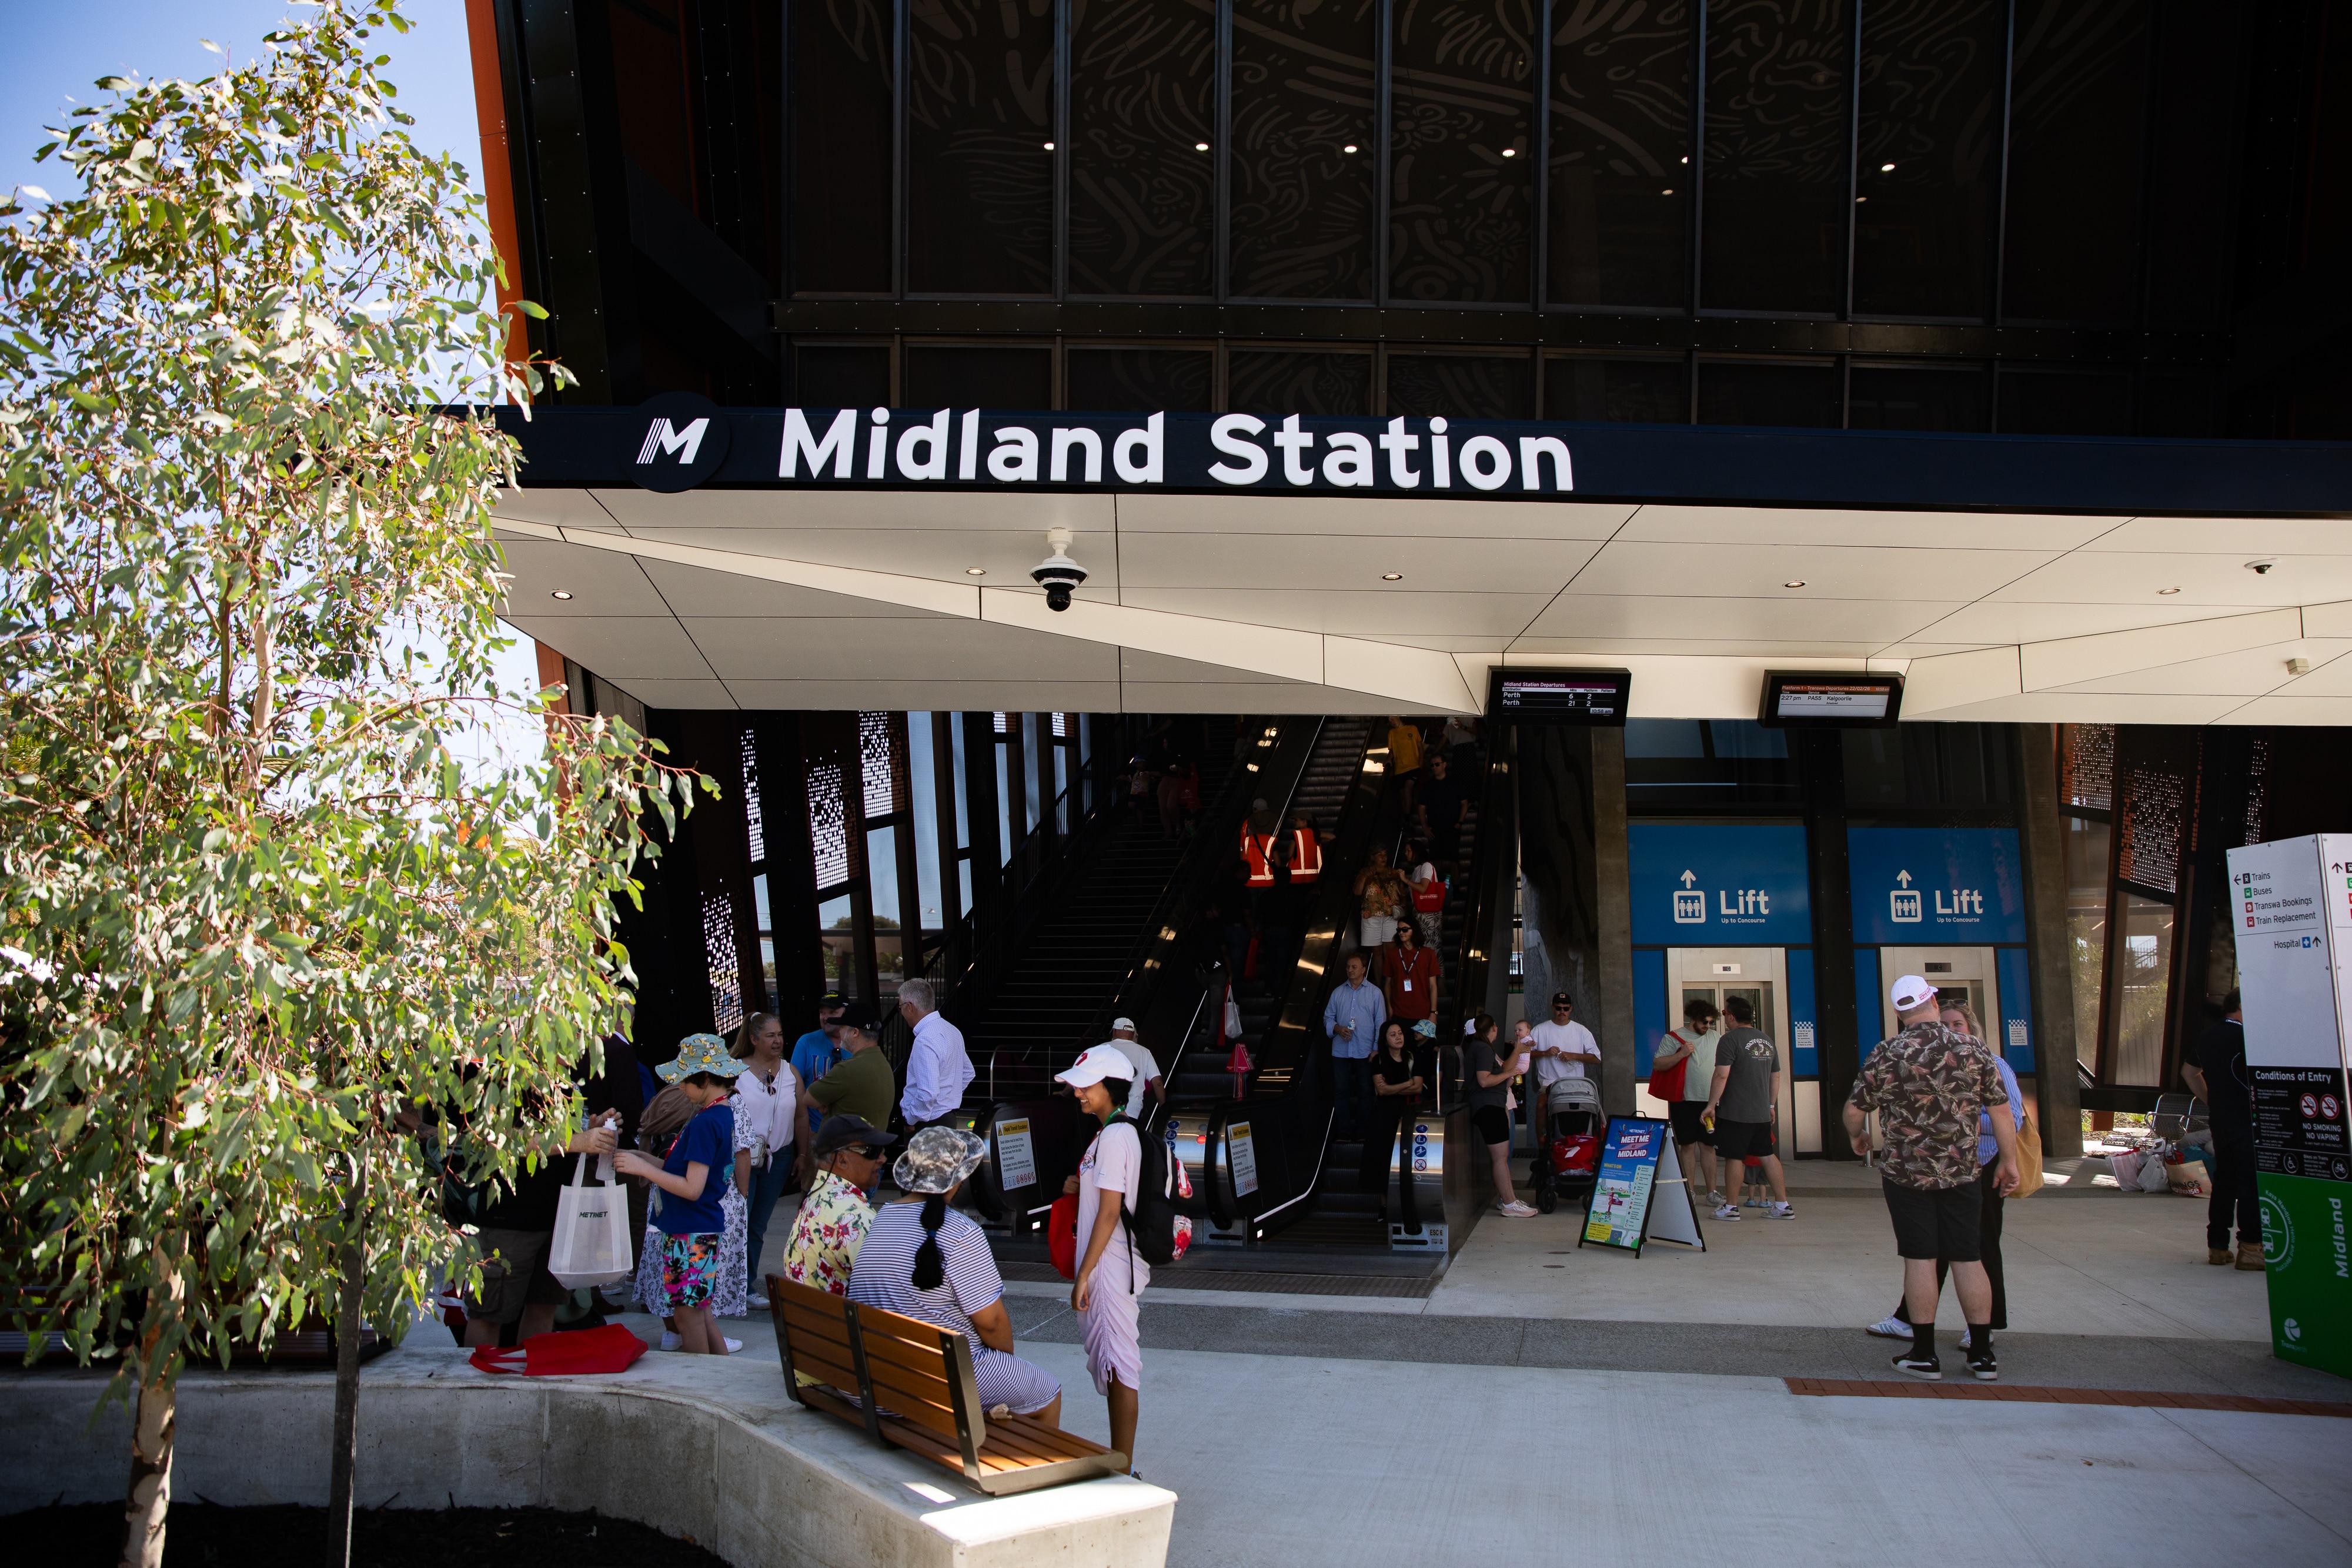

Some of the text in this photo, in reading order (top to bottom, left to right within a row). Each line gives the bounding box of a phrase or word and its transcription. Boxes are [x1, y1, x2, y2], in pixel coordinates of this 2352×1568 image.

[779, 407, 1573, 491] Midland Station
[2252, 872, 2271, 881] Trains
[2253, 886, 2272, 896] Buses
[1720, 890, 1769, 914] Lift
[1935, 890, 1983, 914] Lift
[2254, 897, 2313, 911] Transwa Bookings
[2256, 911, 2316, 925] Train Replacement
[2274, 939, 2301, 949] Hospital
[2256, 1071, 2331, 1084] Conditions of Entry
[2313, 1123, 2341, 1132] SMOKING
[1621, 1135, 1639, 1144] MEET
[2316, 1133, 2340, 1141] VAPING
[1618, 1149, 1646, 1158] MIDLAND
[2328, 1197, 2349, 1278] Midland
